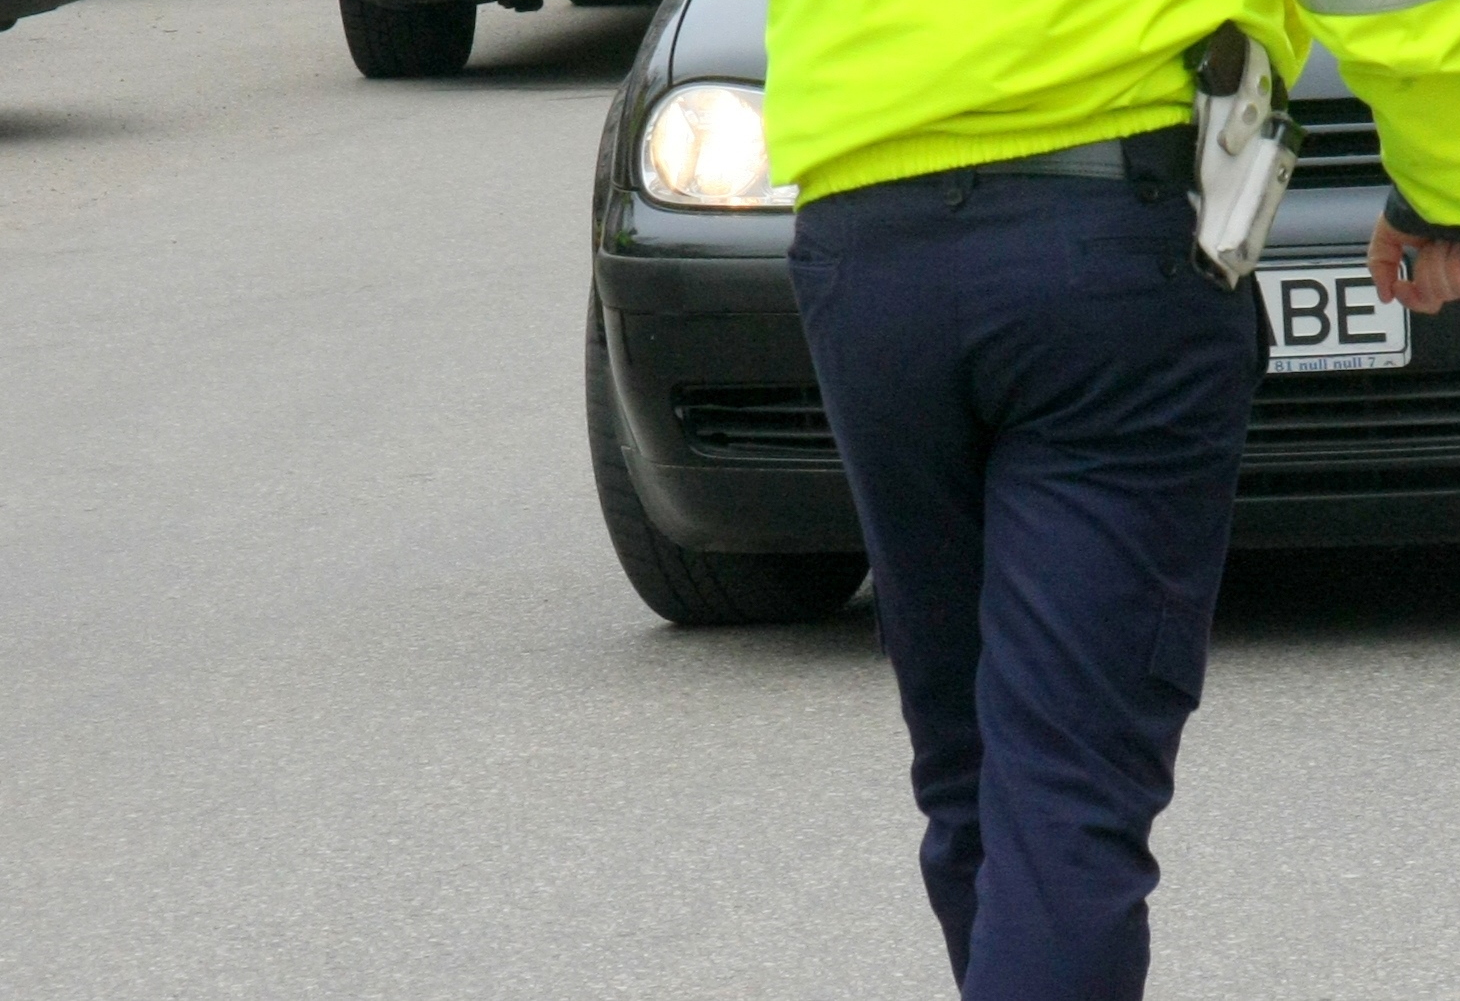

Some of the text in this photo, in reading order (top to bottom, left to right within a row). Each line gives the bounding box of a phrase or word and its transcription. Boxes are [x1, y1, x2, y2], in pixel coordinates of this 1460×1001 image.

[1274, 360, 1293, 373] 81
[1299, 357, 1328, 372] null
[1333, 356, 1362, 370] null
